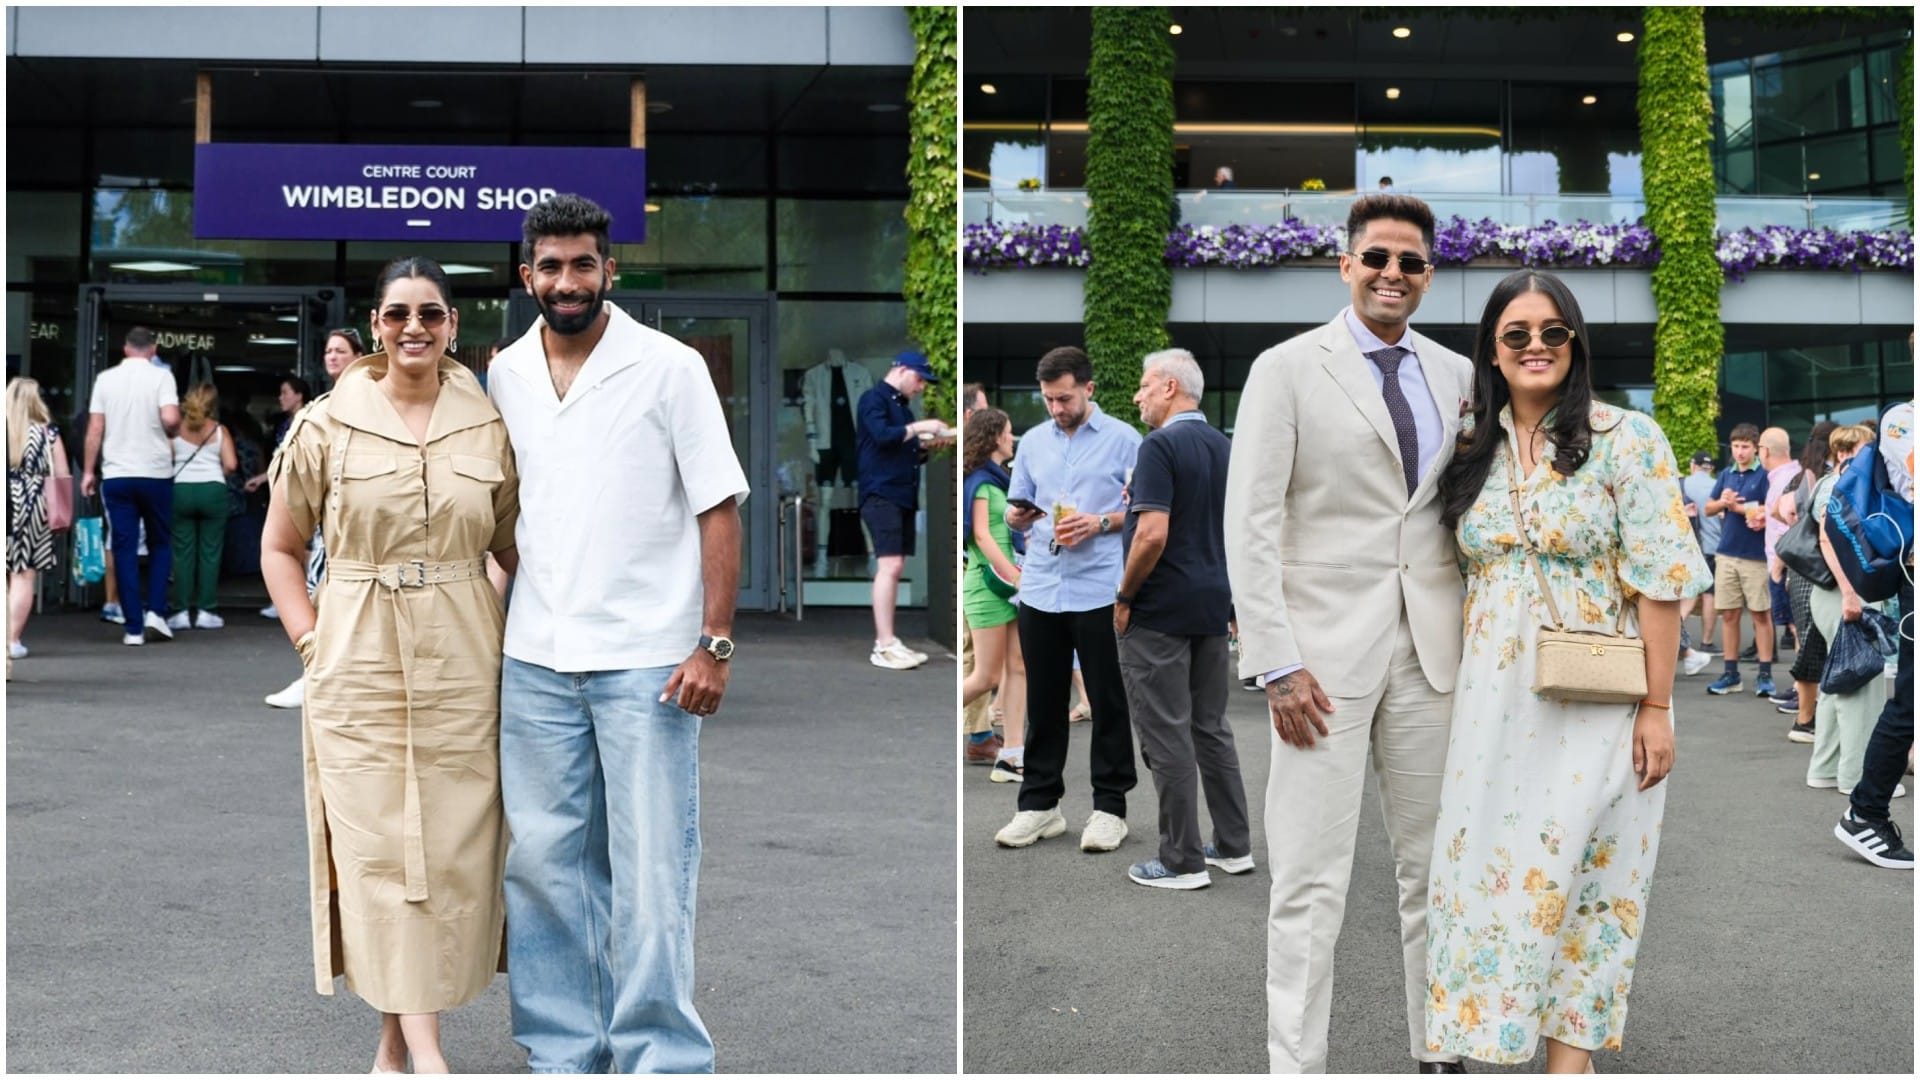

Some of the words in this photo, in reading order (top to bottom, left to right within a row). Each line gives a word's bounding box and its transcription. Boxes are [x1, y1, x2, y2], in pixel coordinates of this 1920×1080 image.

[363, 165, 421, 178] CENTRE
[426, 165, 477, 179] COURT
[282, 185, 465, 210] WIMBLEDON
[477, 187, 557, 210] SHOP
[151, 330, 215, 350] ADWEAR
